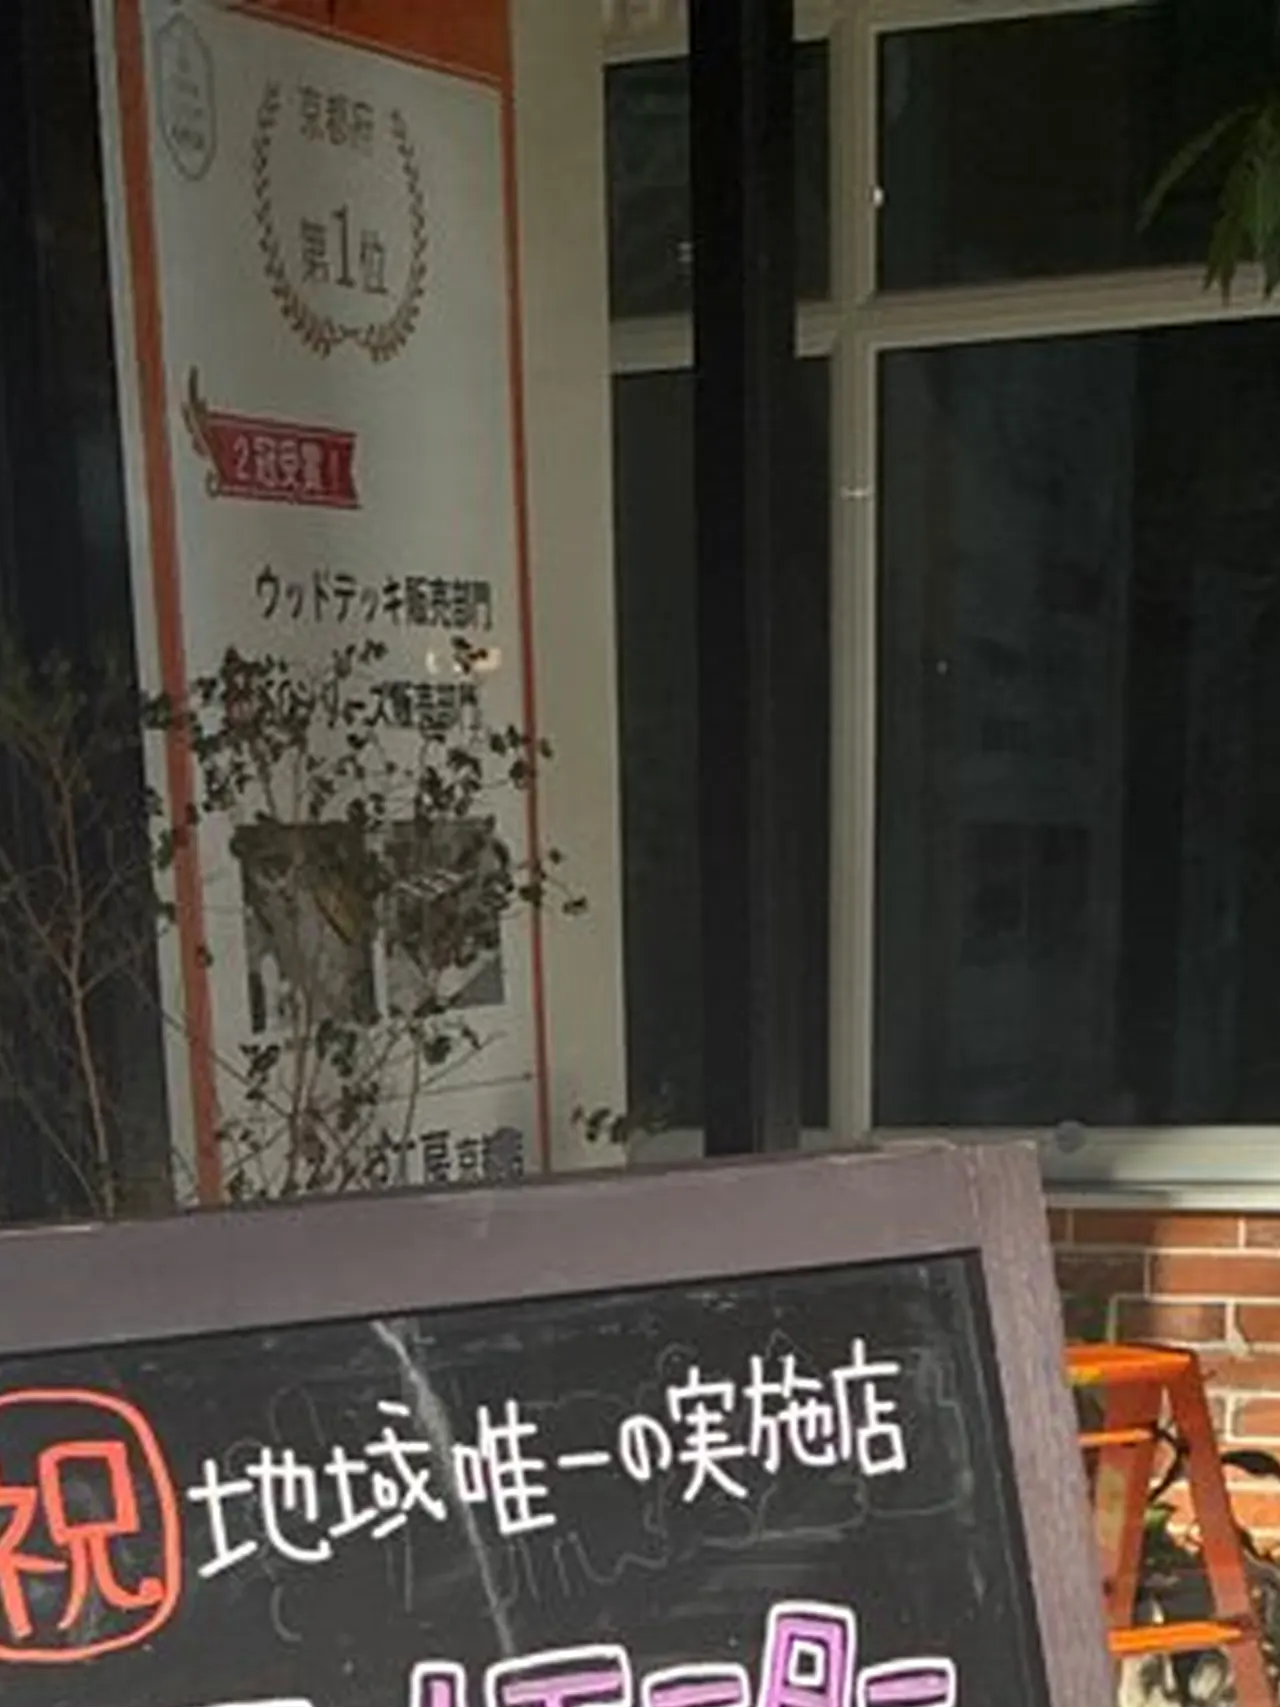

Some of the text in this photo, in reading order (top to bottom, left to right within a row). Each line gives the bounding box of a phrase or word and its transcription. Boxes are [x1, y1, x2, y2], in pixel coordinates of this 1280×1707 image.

[299, 204, 388, 294] 第1位
[188, 1338, 908, 1580] 地域唯一の実施店
